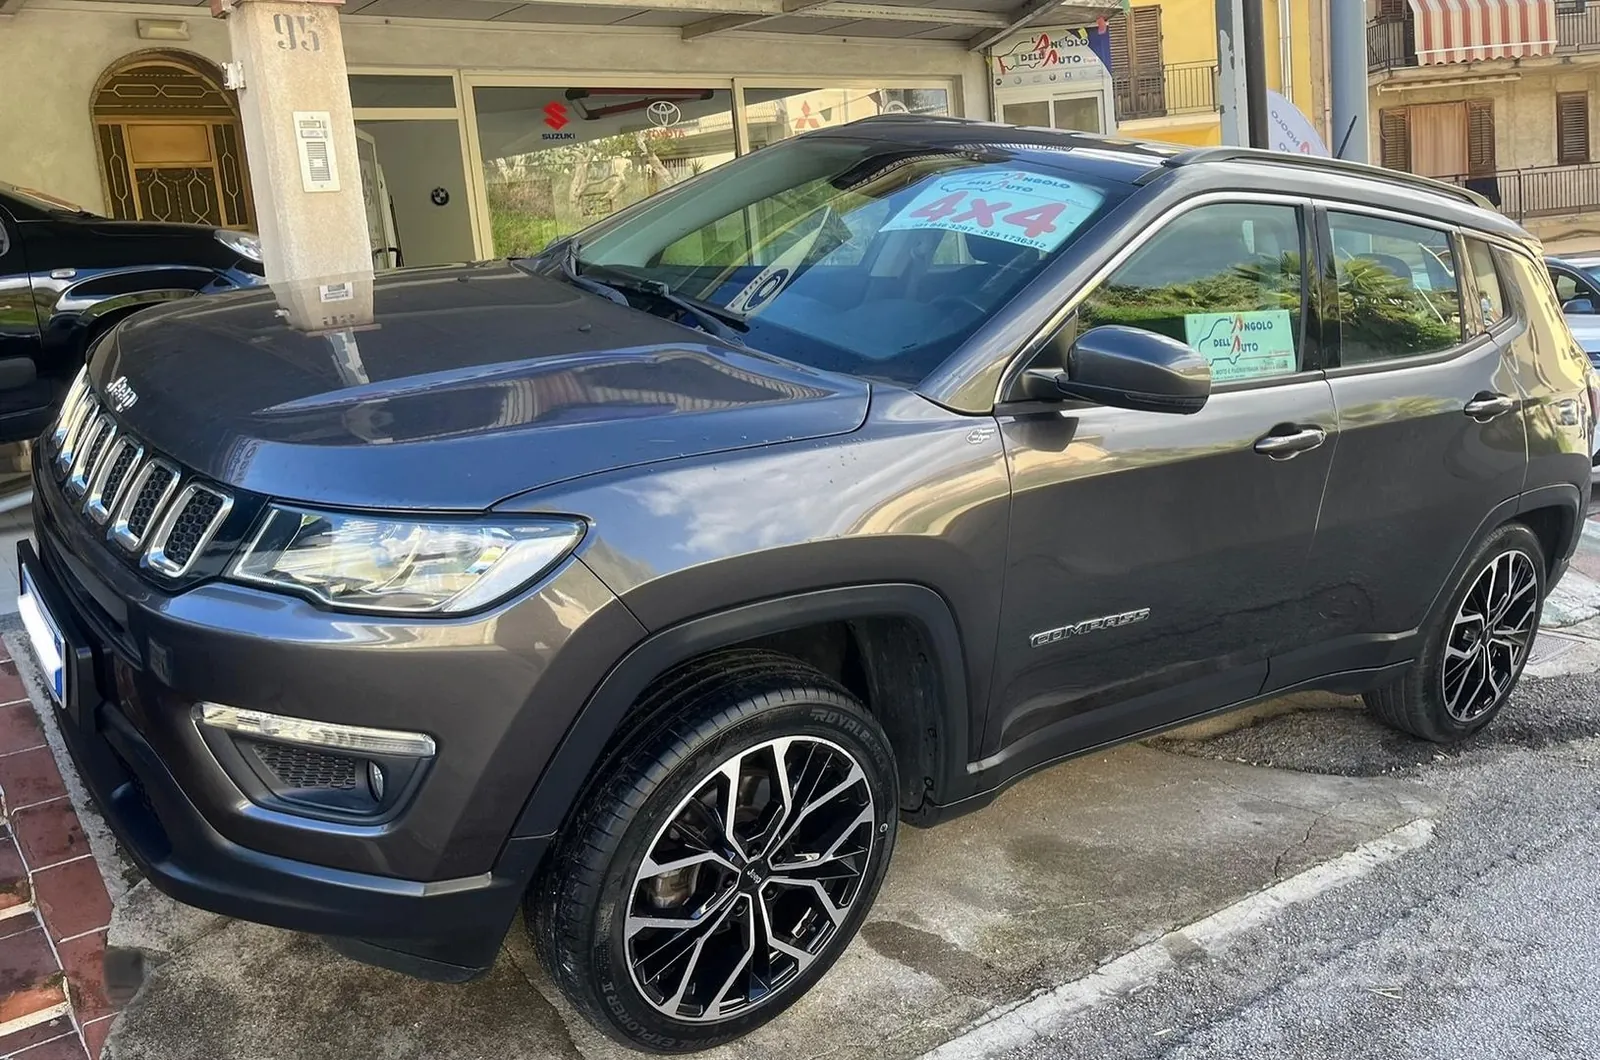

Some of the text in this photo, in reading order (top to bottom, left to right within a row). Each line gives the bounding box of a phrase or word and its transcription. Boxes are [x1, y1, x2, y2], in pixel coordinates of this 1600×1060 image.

[273, 14, 320, 51] 95
[646, 128, 687, 139] TOYOTA
[949, 223, 975, 233] 3297
[980, 229, 1001, 238] 333
[104, 376, 139, 413] Jeep
[1029, 607, 1151, 648] COMPASS
[746, 868, 762, 884] Jeep
